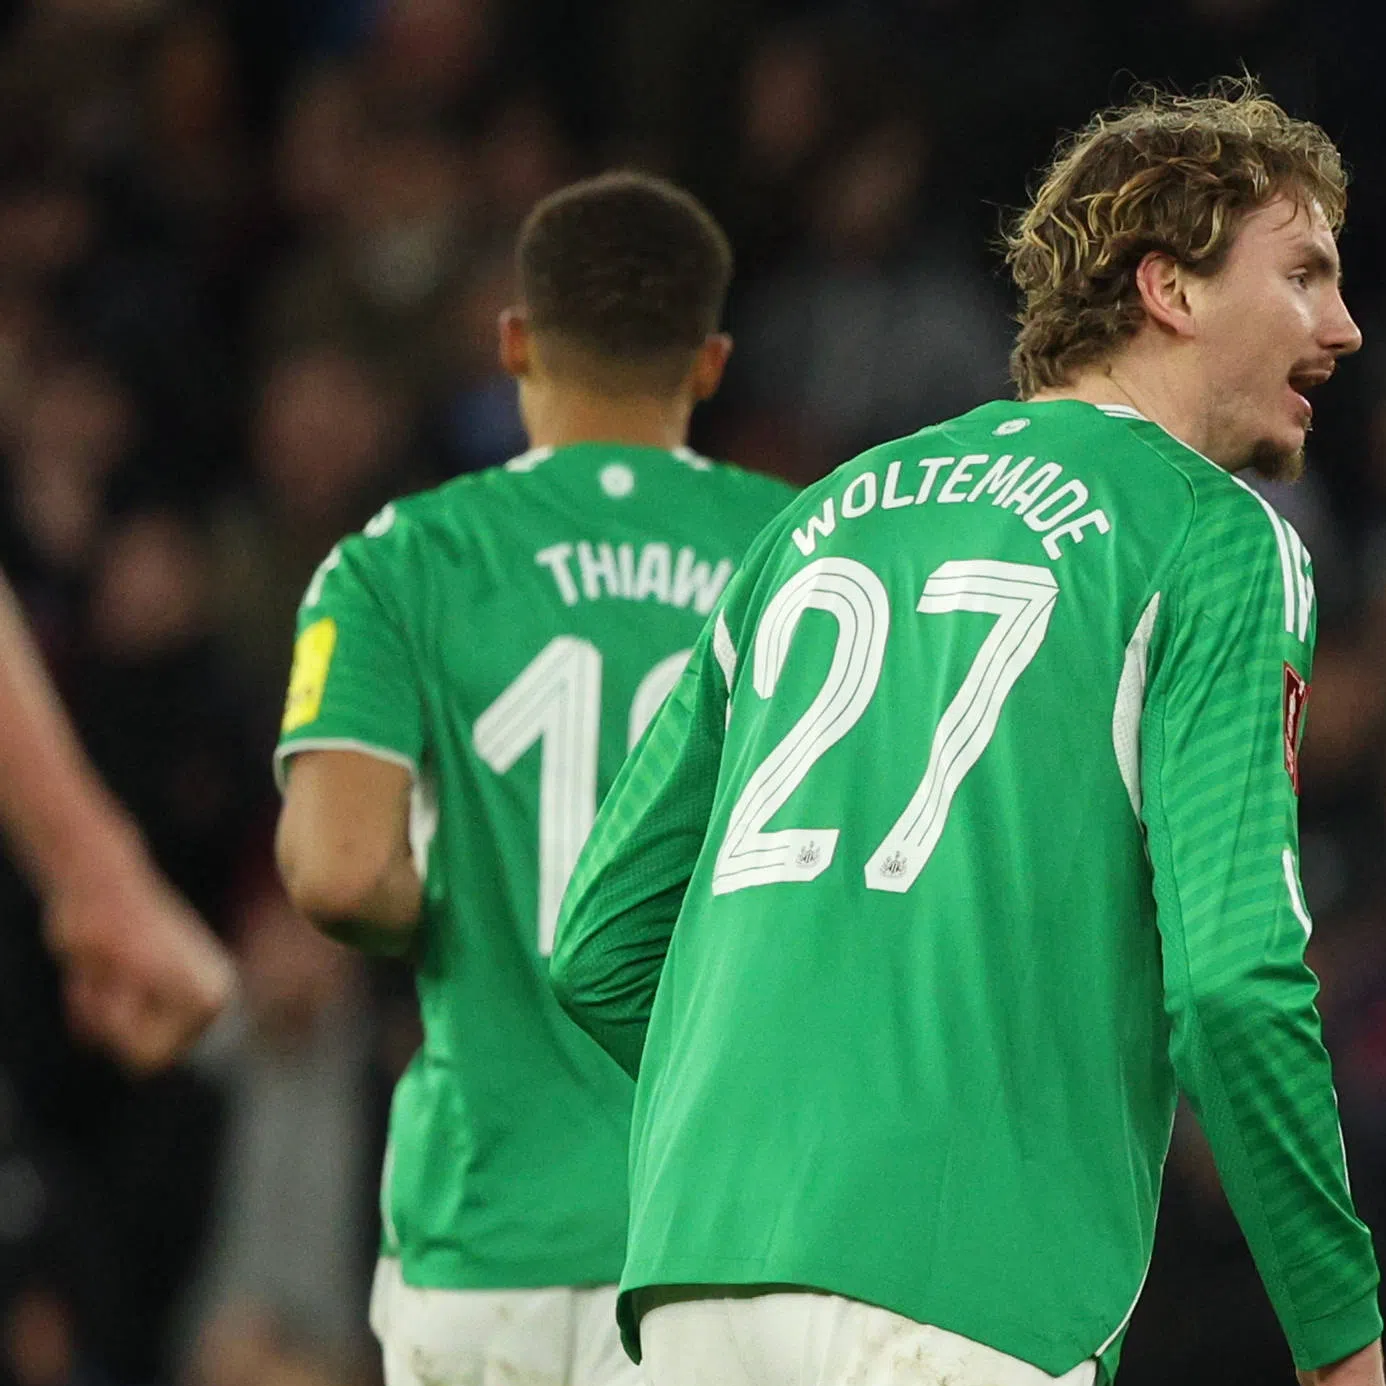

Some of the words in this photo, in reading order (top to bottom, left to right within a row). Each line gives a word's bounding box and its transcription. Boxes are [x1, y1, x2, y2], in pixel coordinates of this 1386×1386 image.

[791, 453, 1112, 561] WOLTEMADE
[535, 540, 733, 616] THIAW
[711, 556, 1060, 896] 27
